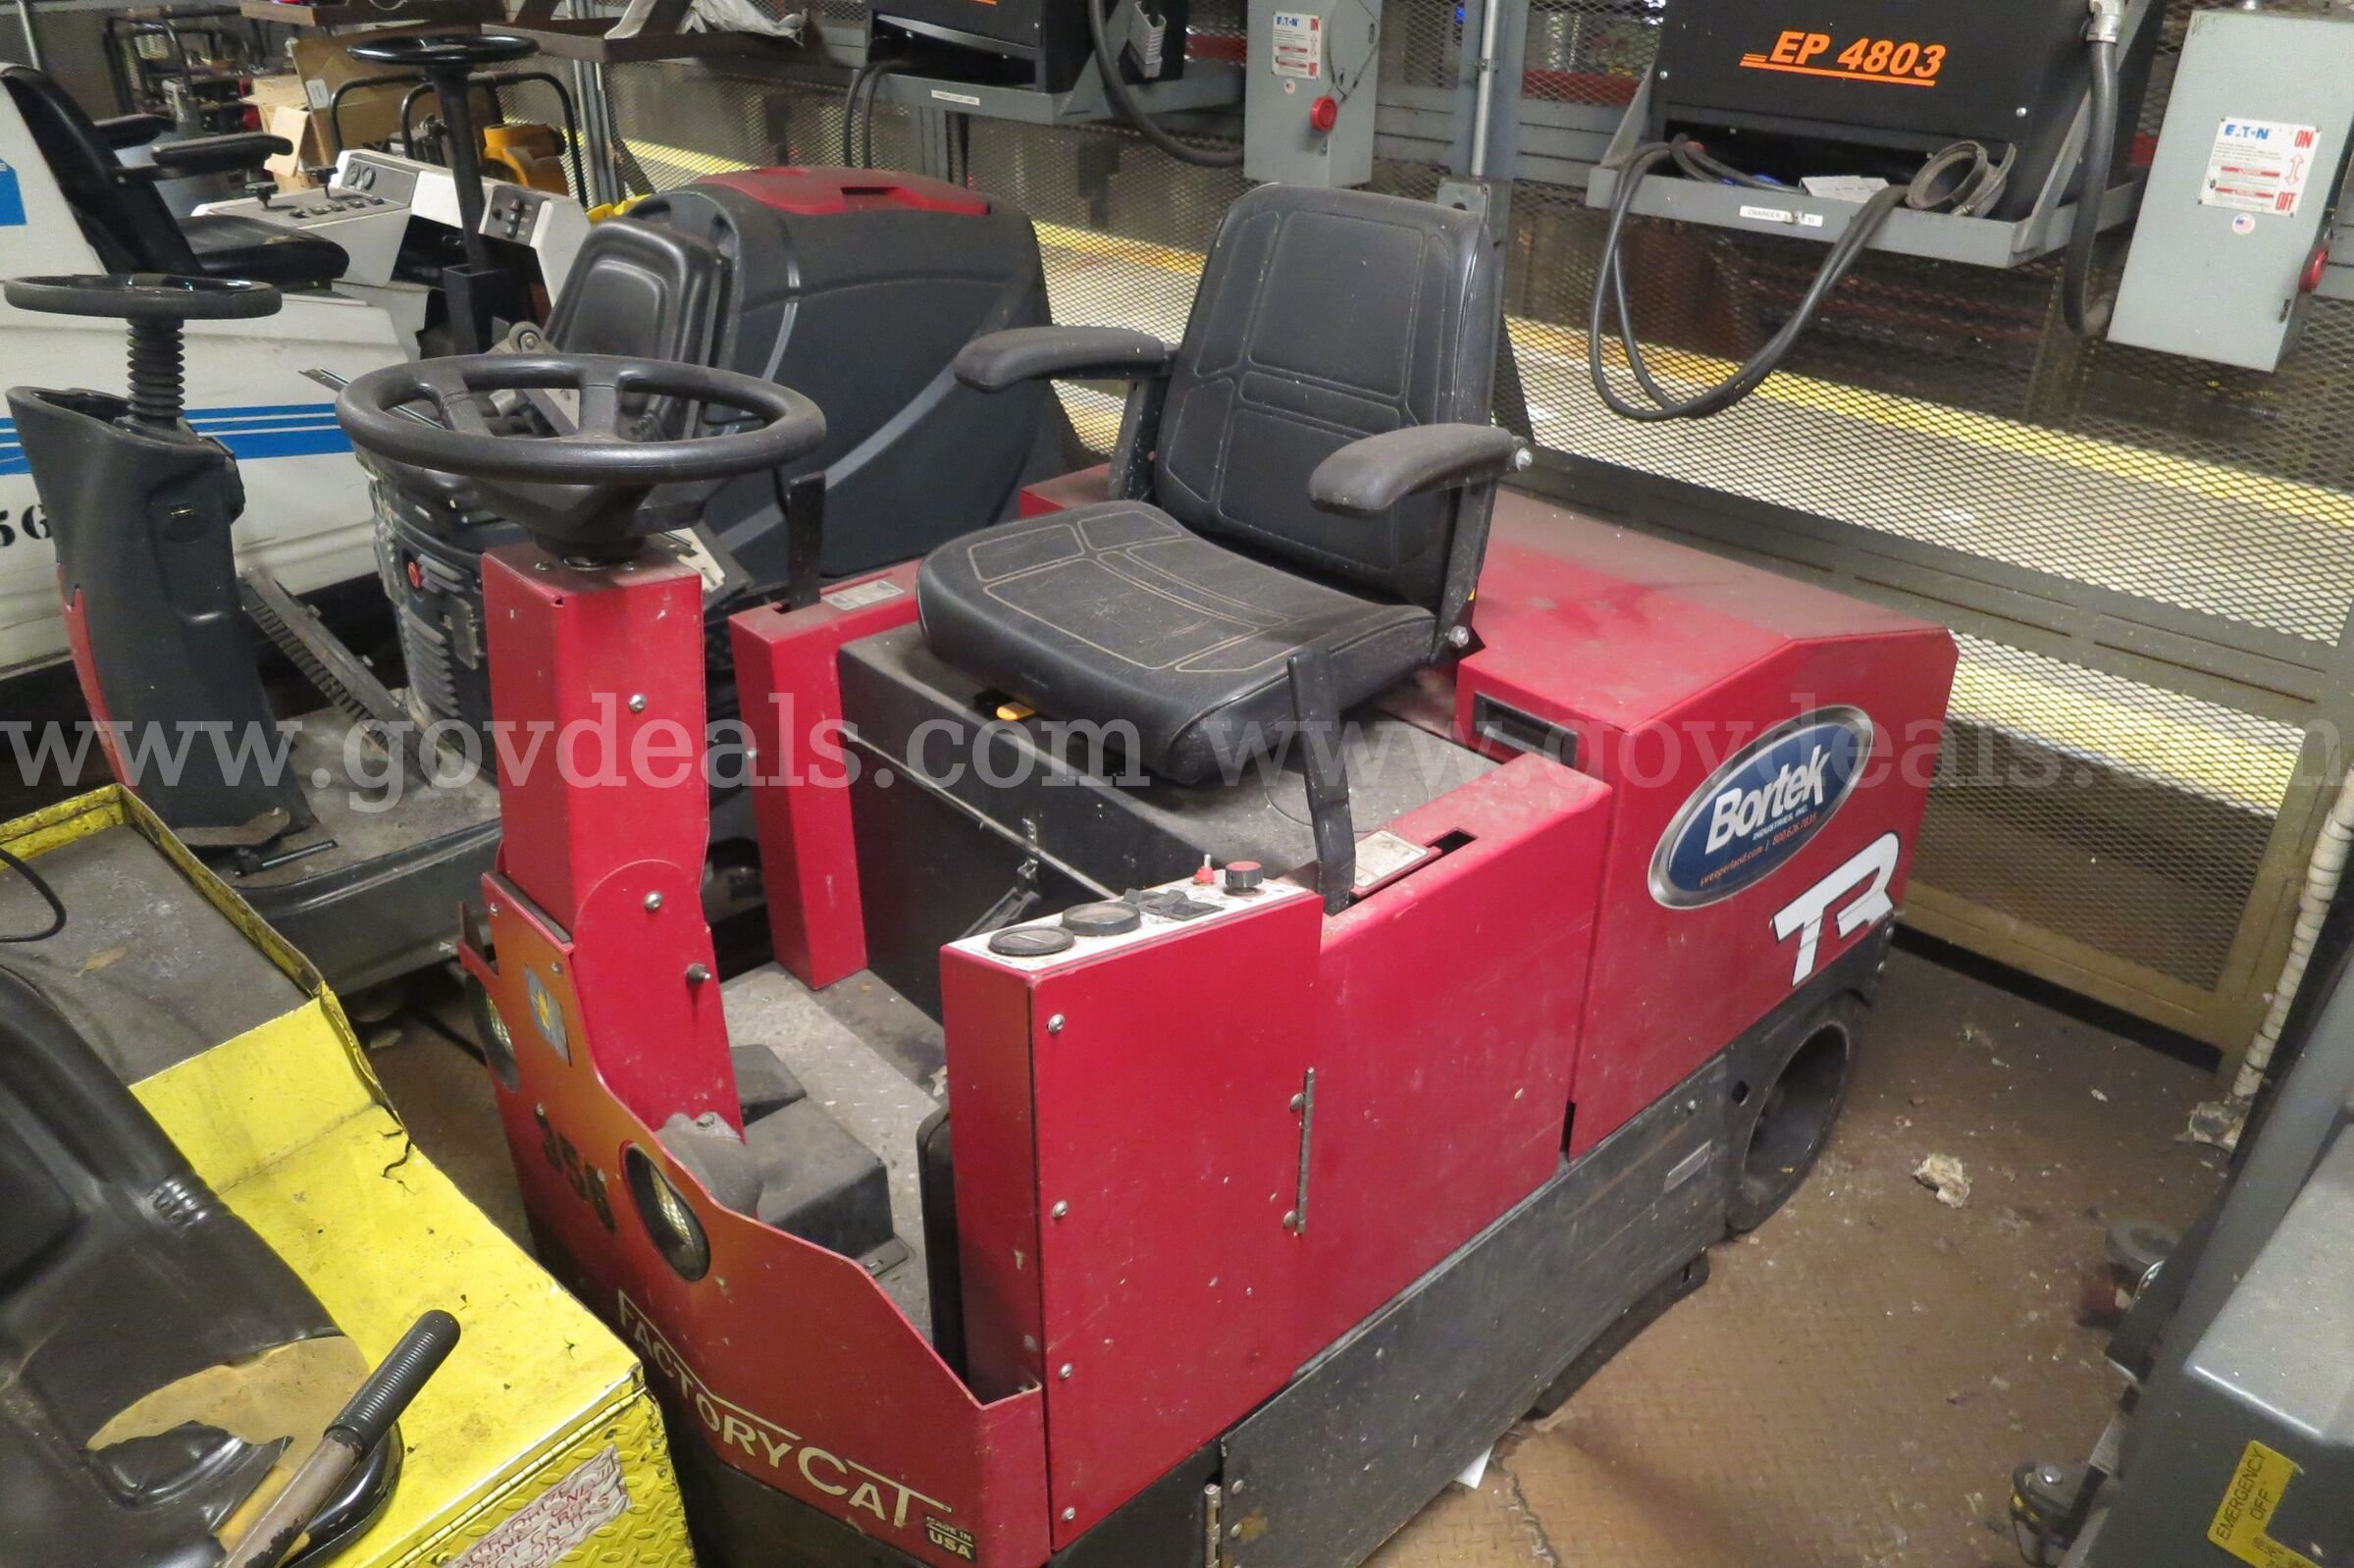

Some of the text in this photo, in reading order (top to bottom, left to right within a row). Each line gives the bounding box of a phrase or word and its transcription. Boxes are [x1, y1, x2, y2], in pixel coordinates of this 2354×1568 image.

[1769, 30, 1946, 78] EP 4803
[2293, 129, 2315, 149] ON
[2275, 191, 2297, 212] OFF
[1705, 744, 1830, 855] Bortek
[1771, 832, 1899, 986] TR
[2216, 1449, 2267, 1541] EMERGENCY
[2249, 1488, 2270, 1521] OFF
[928, 1529, 972, 1560] USA
